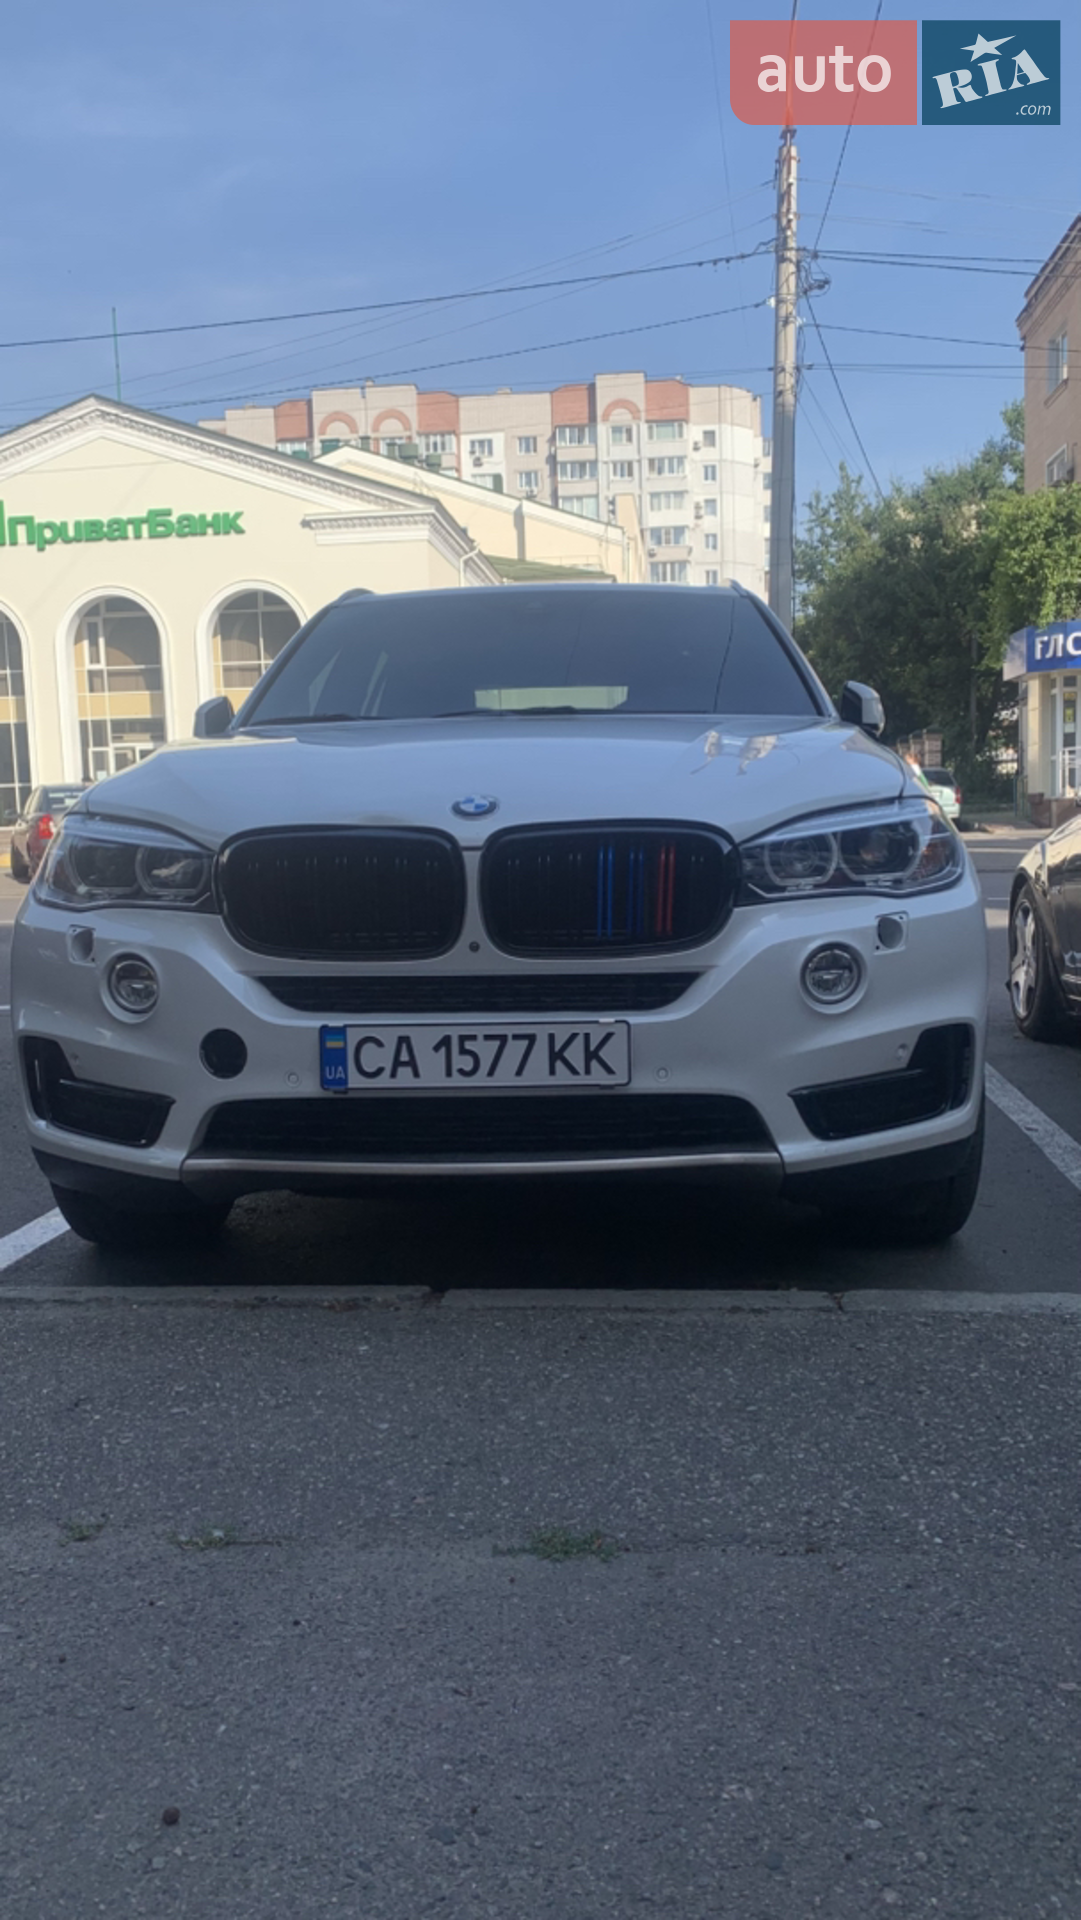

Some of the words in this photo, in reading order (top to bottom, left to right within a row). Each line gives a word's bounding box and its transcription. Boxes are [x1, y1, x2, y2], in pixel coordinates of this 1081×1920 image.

[7, 508, 245, 551] ПриватБанк
[325, 1065, 346, 1080] UA
[353, 1035, 421, 1079] CA
[432, 1032, 537, 1078] 1577
[547, 1031, 617, 1076] KK
